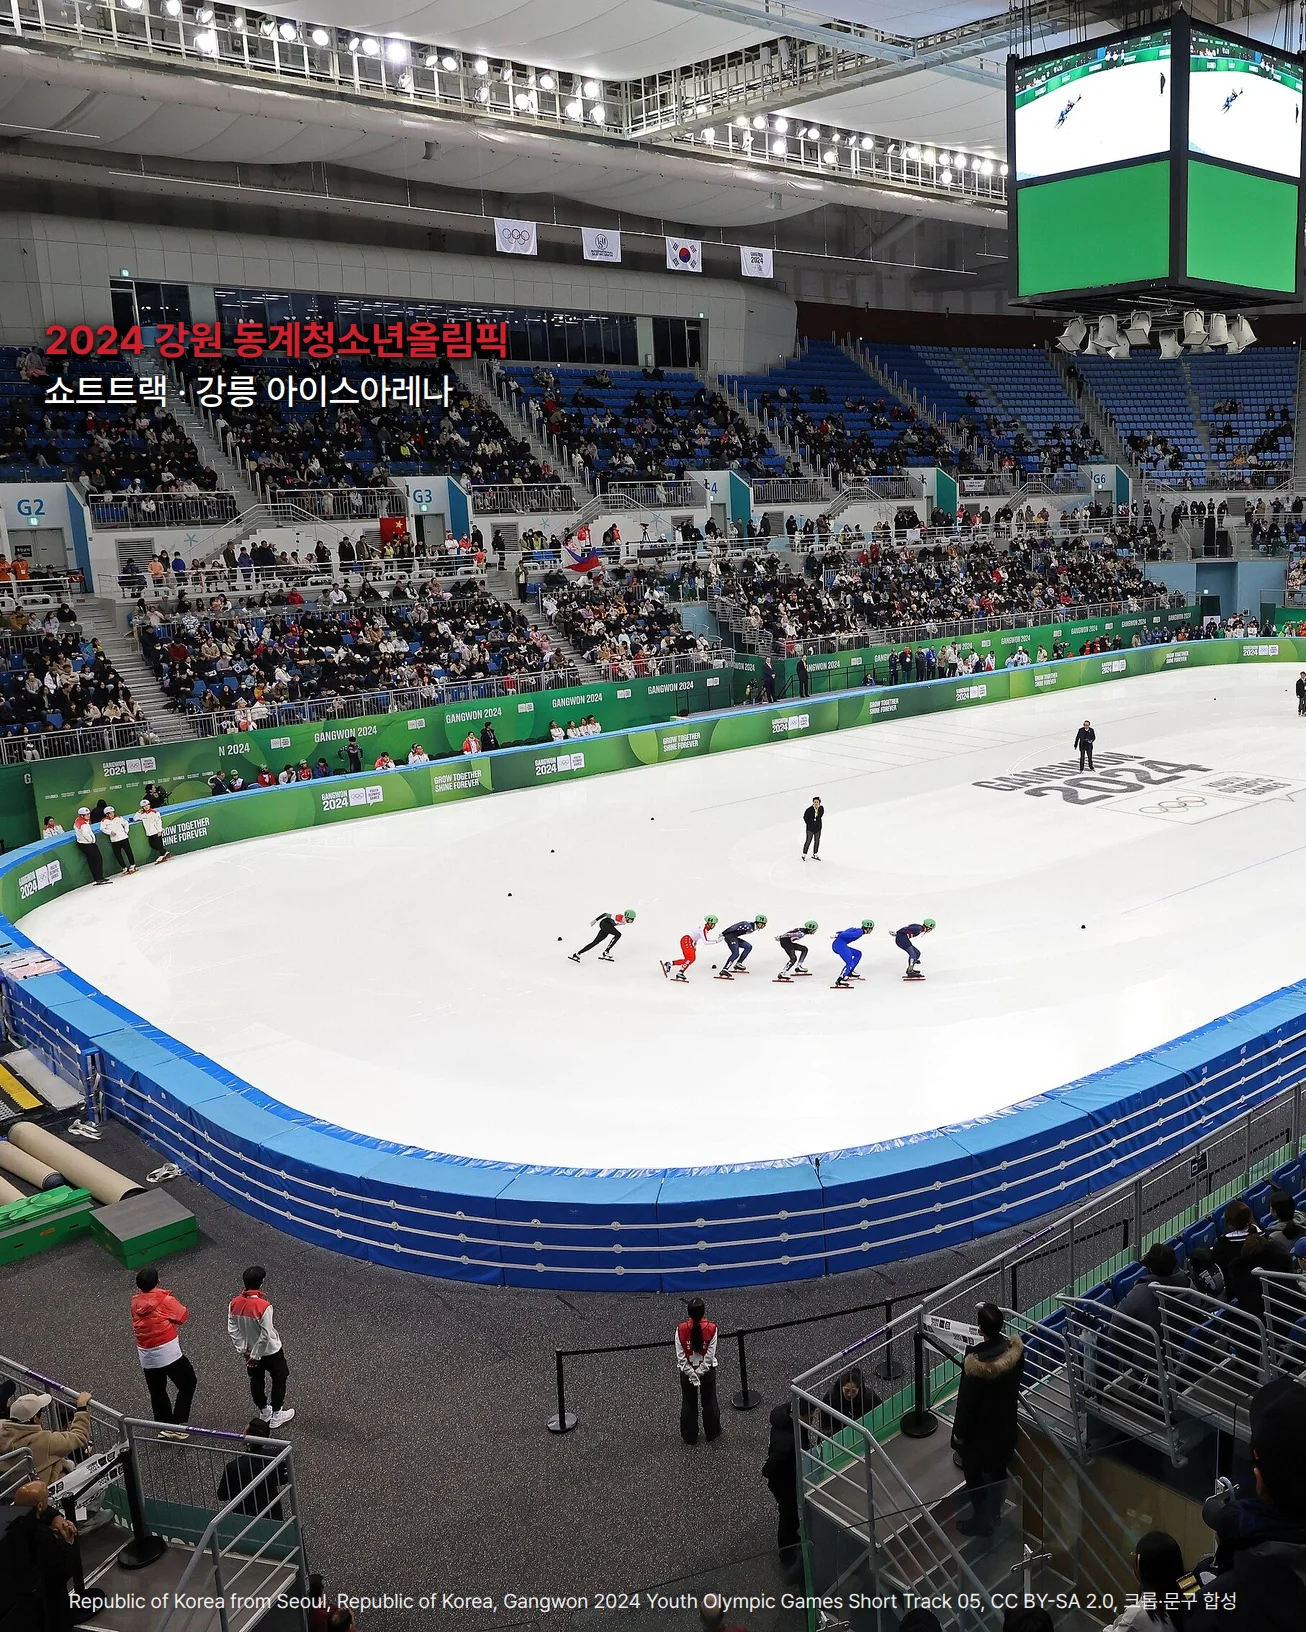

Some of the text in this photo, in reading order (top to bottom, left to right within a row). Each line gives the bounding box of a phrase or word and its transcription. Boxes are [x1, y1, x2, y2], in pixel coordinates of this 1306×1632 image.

[1094, 474, 1106, 484] G6
[412, 487, 432, 504] G3
[17, 498, 46, 516] G2
[828, 660, 840, 669] 2024
[648, 680, 694, 695] GANGWON 2024
[552, 693, 603, 708] GANGWON 2024
[956, 692, 969, 701] 2024
[446, 707, 502, 724] GANGWON 2024
[314, 726, 377, 742] GANGWON 2024
[772, 722, 788, 733] 2024
[227, 743, 250, 755] 2024
[678, 740, 699, 749] FOREVER
[104, 766, 126, 777] 2024
[434, 770, 482, 784] GROW TOGETHER
[536, 764, 557, 776] 2024
[435, 779, 480, 793] SHINE FOREVER
[1024, 760, 1213, 806] 2024
[322, 790, 348, 800] GANGWON
[323, 798, 349, 811] 2024
[162, 817, 210, 837] ROW TOGETHER
[162, 827, 208, 846] HINE FOREVER
[20, 880, 37, 900] 2024
